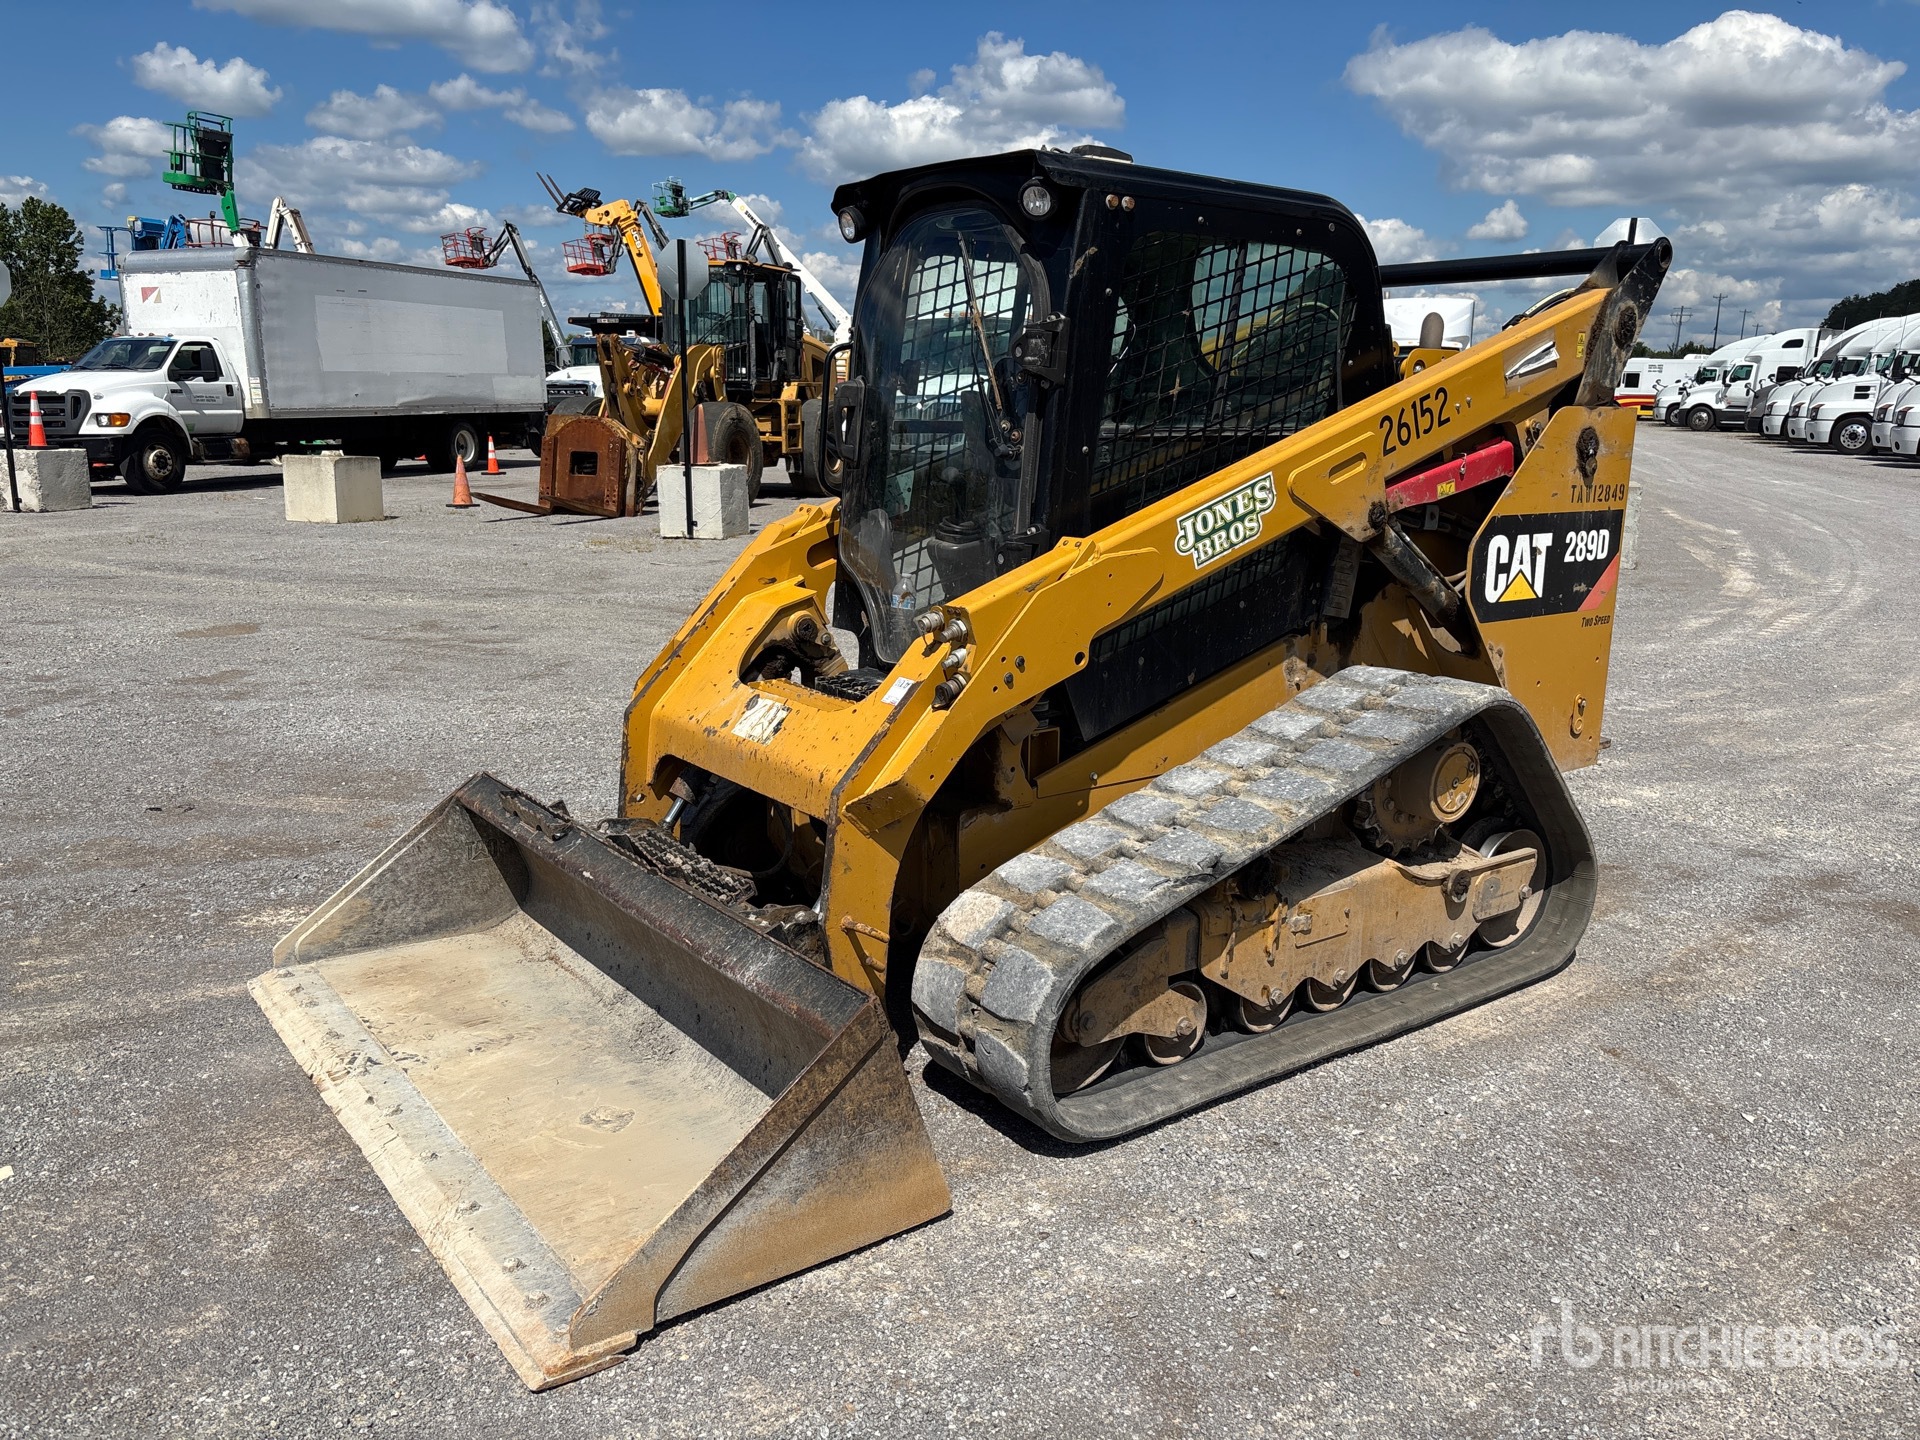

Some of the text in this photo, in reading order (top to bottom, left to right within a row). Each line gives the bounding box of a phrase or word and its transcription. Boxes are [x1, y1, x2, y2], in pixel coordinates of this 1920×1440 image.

[630, 227, 642, 249] JCB
[1379, 387, 1451, 457] 26152
[1177, 477, 1274, 552] JONES
[1194, 512, 1261, 564] BROS
[1485, 529, 1610, 604] CAT 289D
